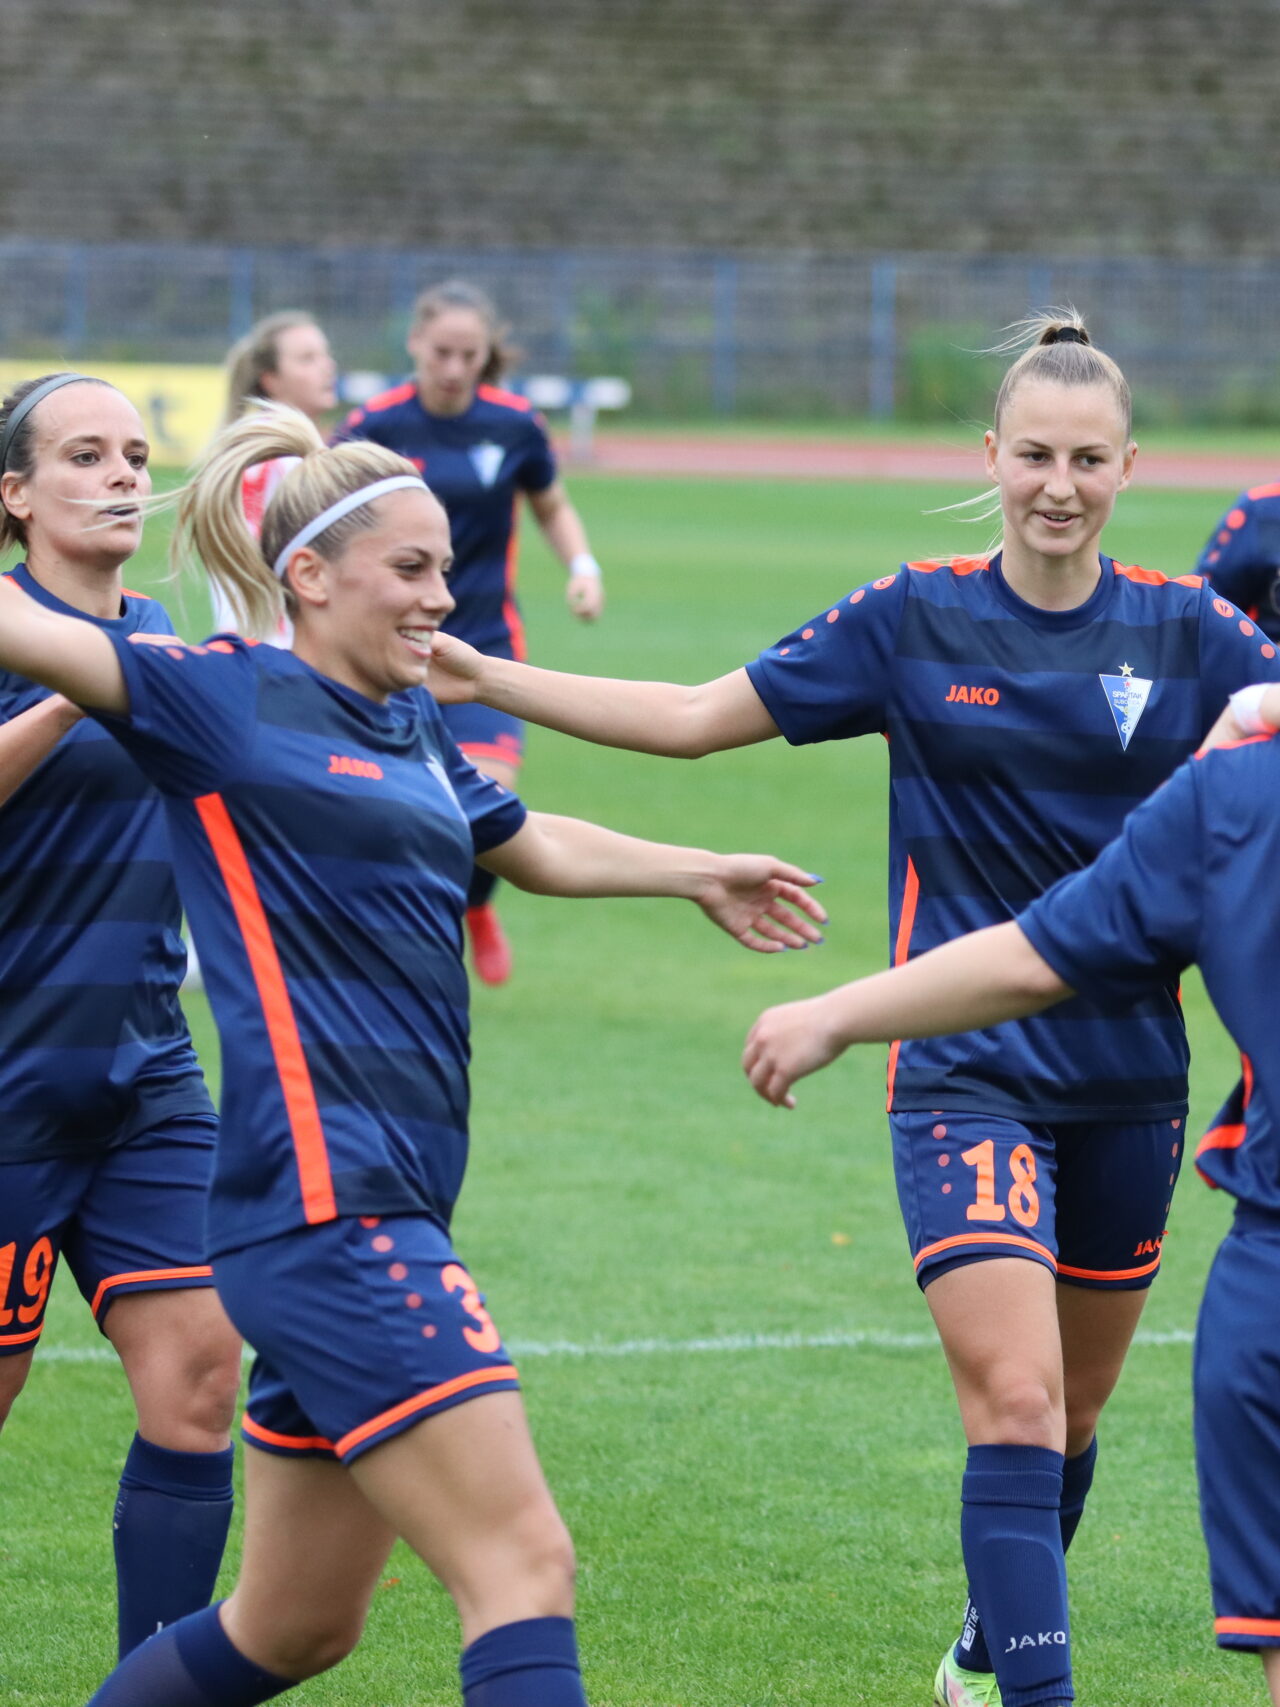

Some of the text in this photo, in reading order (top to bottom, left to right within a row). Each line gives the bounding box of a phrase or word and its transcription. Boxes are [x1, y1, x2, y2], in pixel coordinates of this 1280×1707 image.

[945, 685, 999, 706] JAKO
[961, 1139, 1040, 1228] 18
[1133, 1230, 1168, 1257] JAK
[0, 1236, 54, 1327] 19
[441, 1264, 500, 1353] 3
[1004, 1631, 1067, 1653] JAKO
